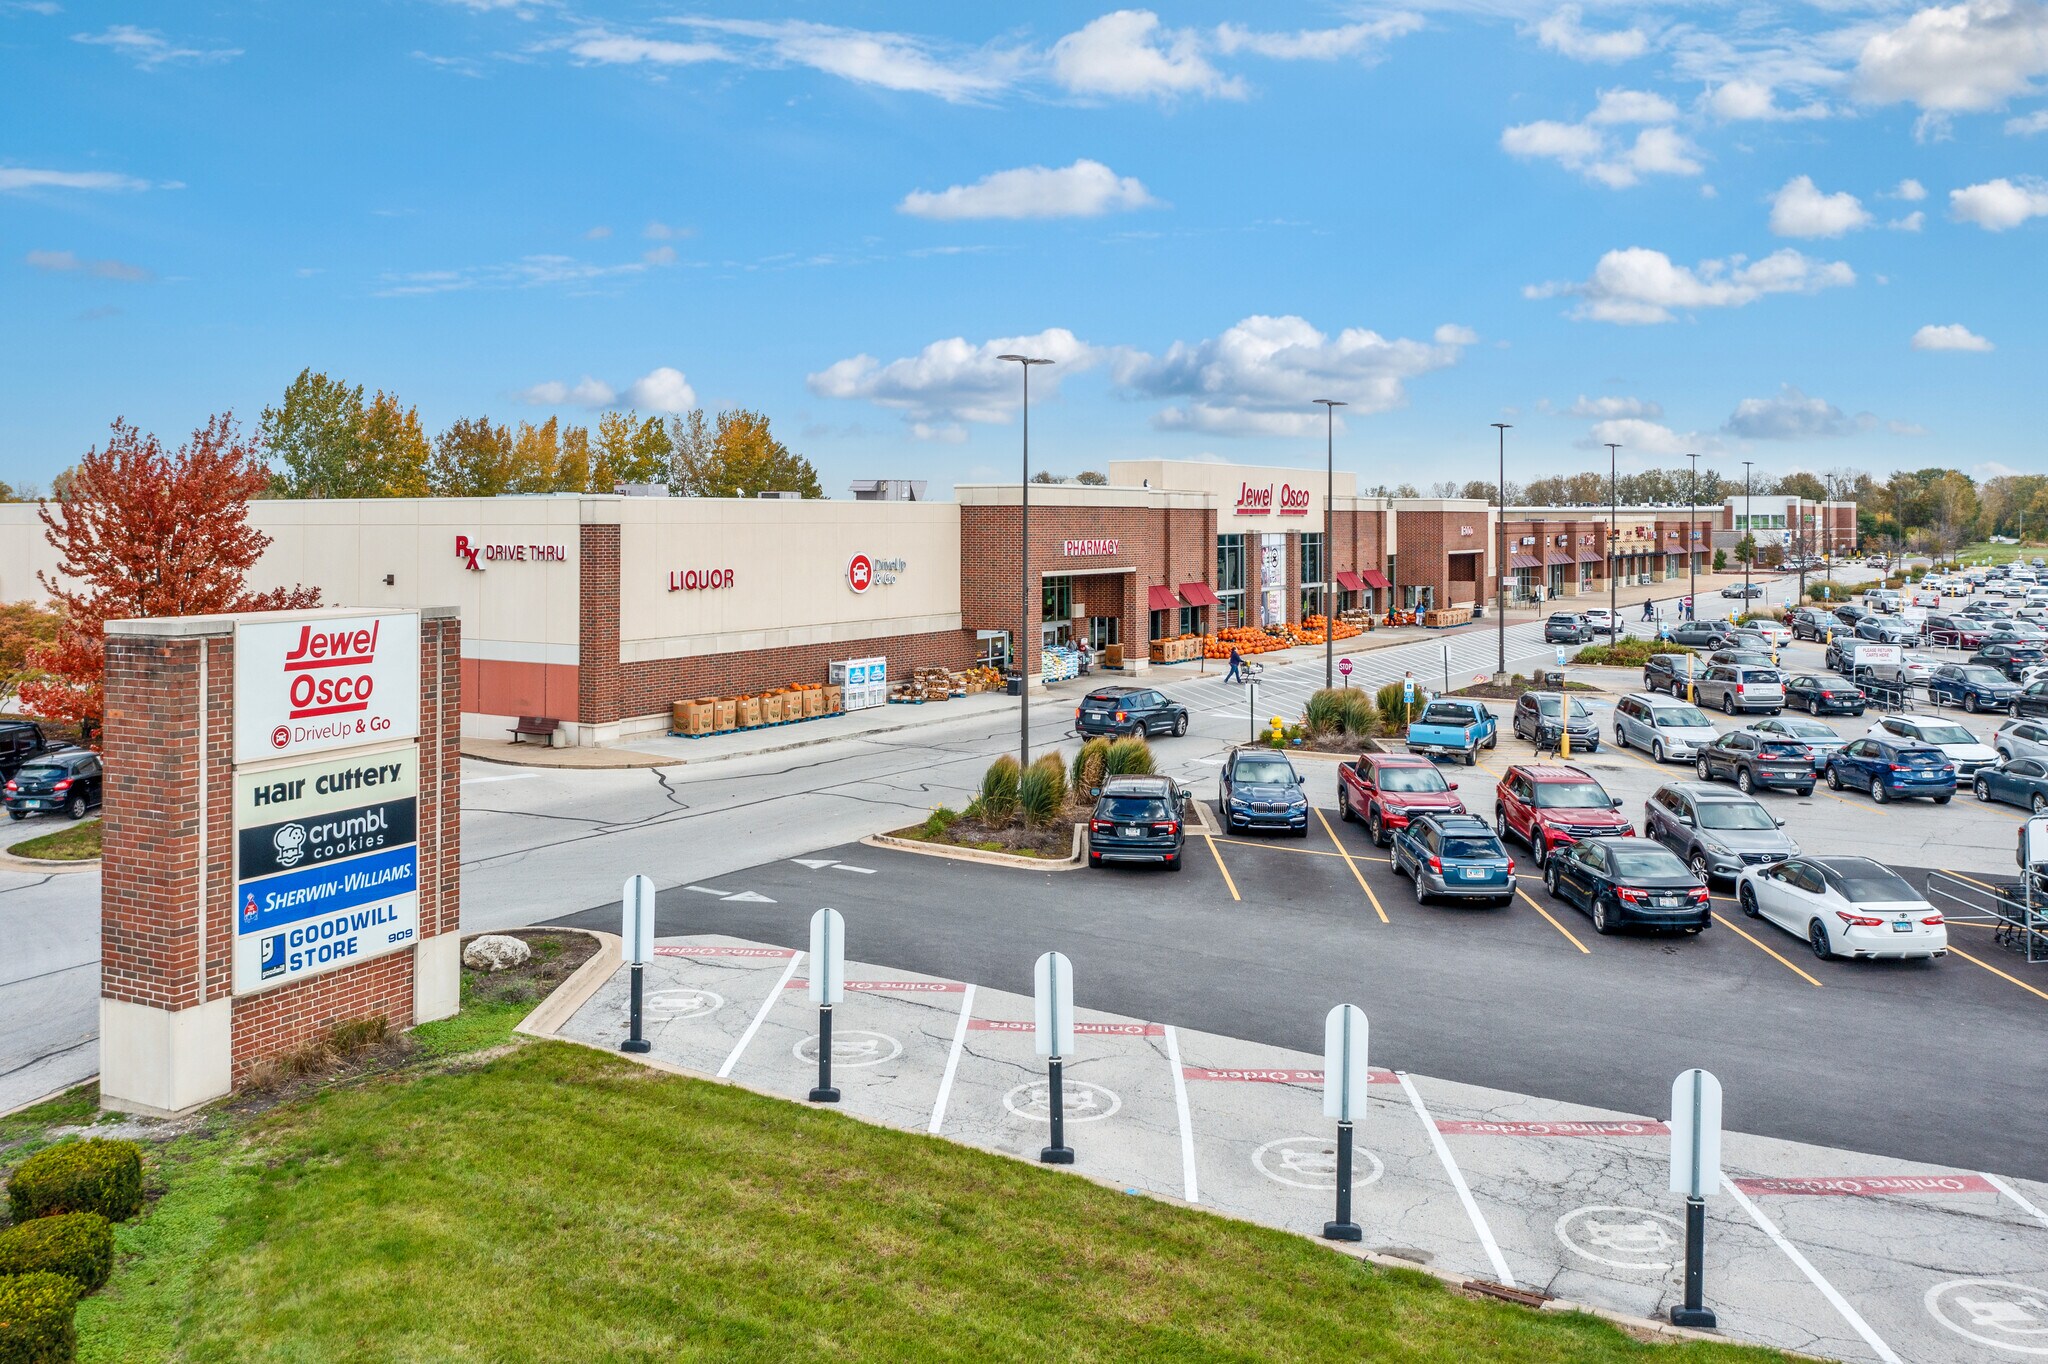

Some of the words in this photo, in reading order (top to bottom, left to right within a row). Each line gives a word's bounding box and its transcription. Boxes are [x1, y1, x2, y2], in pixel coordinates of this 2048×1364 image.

[1237, 482, 1274, 506] Jewel
[1281, 483, 1310, 507] Osco
[486, 544, 525, 561] DRIVE
[528, 544, 566, 561] THRU
[1065, 540, 1119, 556] PHARMACY
[670, 568, 734, 591] LIQUOR
[286, 619, 380, 660] Jewel
[1339, 662, 1353, 671] STOP
[290, 674, 374, 708] Osco
[294, 721, 351, 743] DriveUp
[355, 718, 366, 734] &
[370, 716, 391, 732] Go
[309, 807, 388, 844] crumbl
[313, 834, 385, 859] cookies
[290, 904, 398, 948] GOODWILL
[388, 928, 413, 944] 909
[290, 936, 358, 972] STORE
[721, 948, 783, 957] Online
[879, 982, 947, 991] Online
[990, 1022, 1035, 1031] ders
[1207, 1071, 1289, 1081] Orders
[1461, 1123, 1550, 1134] Orders
[1556, 1123, 1643, 1133] Online
[1763, 1180, 1862, 1193] Orders
[1865, 1178, 1965, 1191] Online
